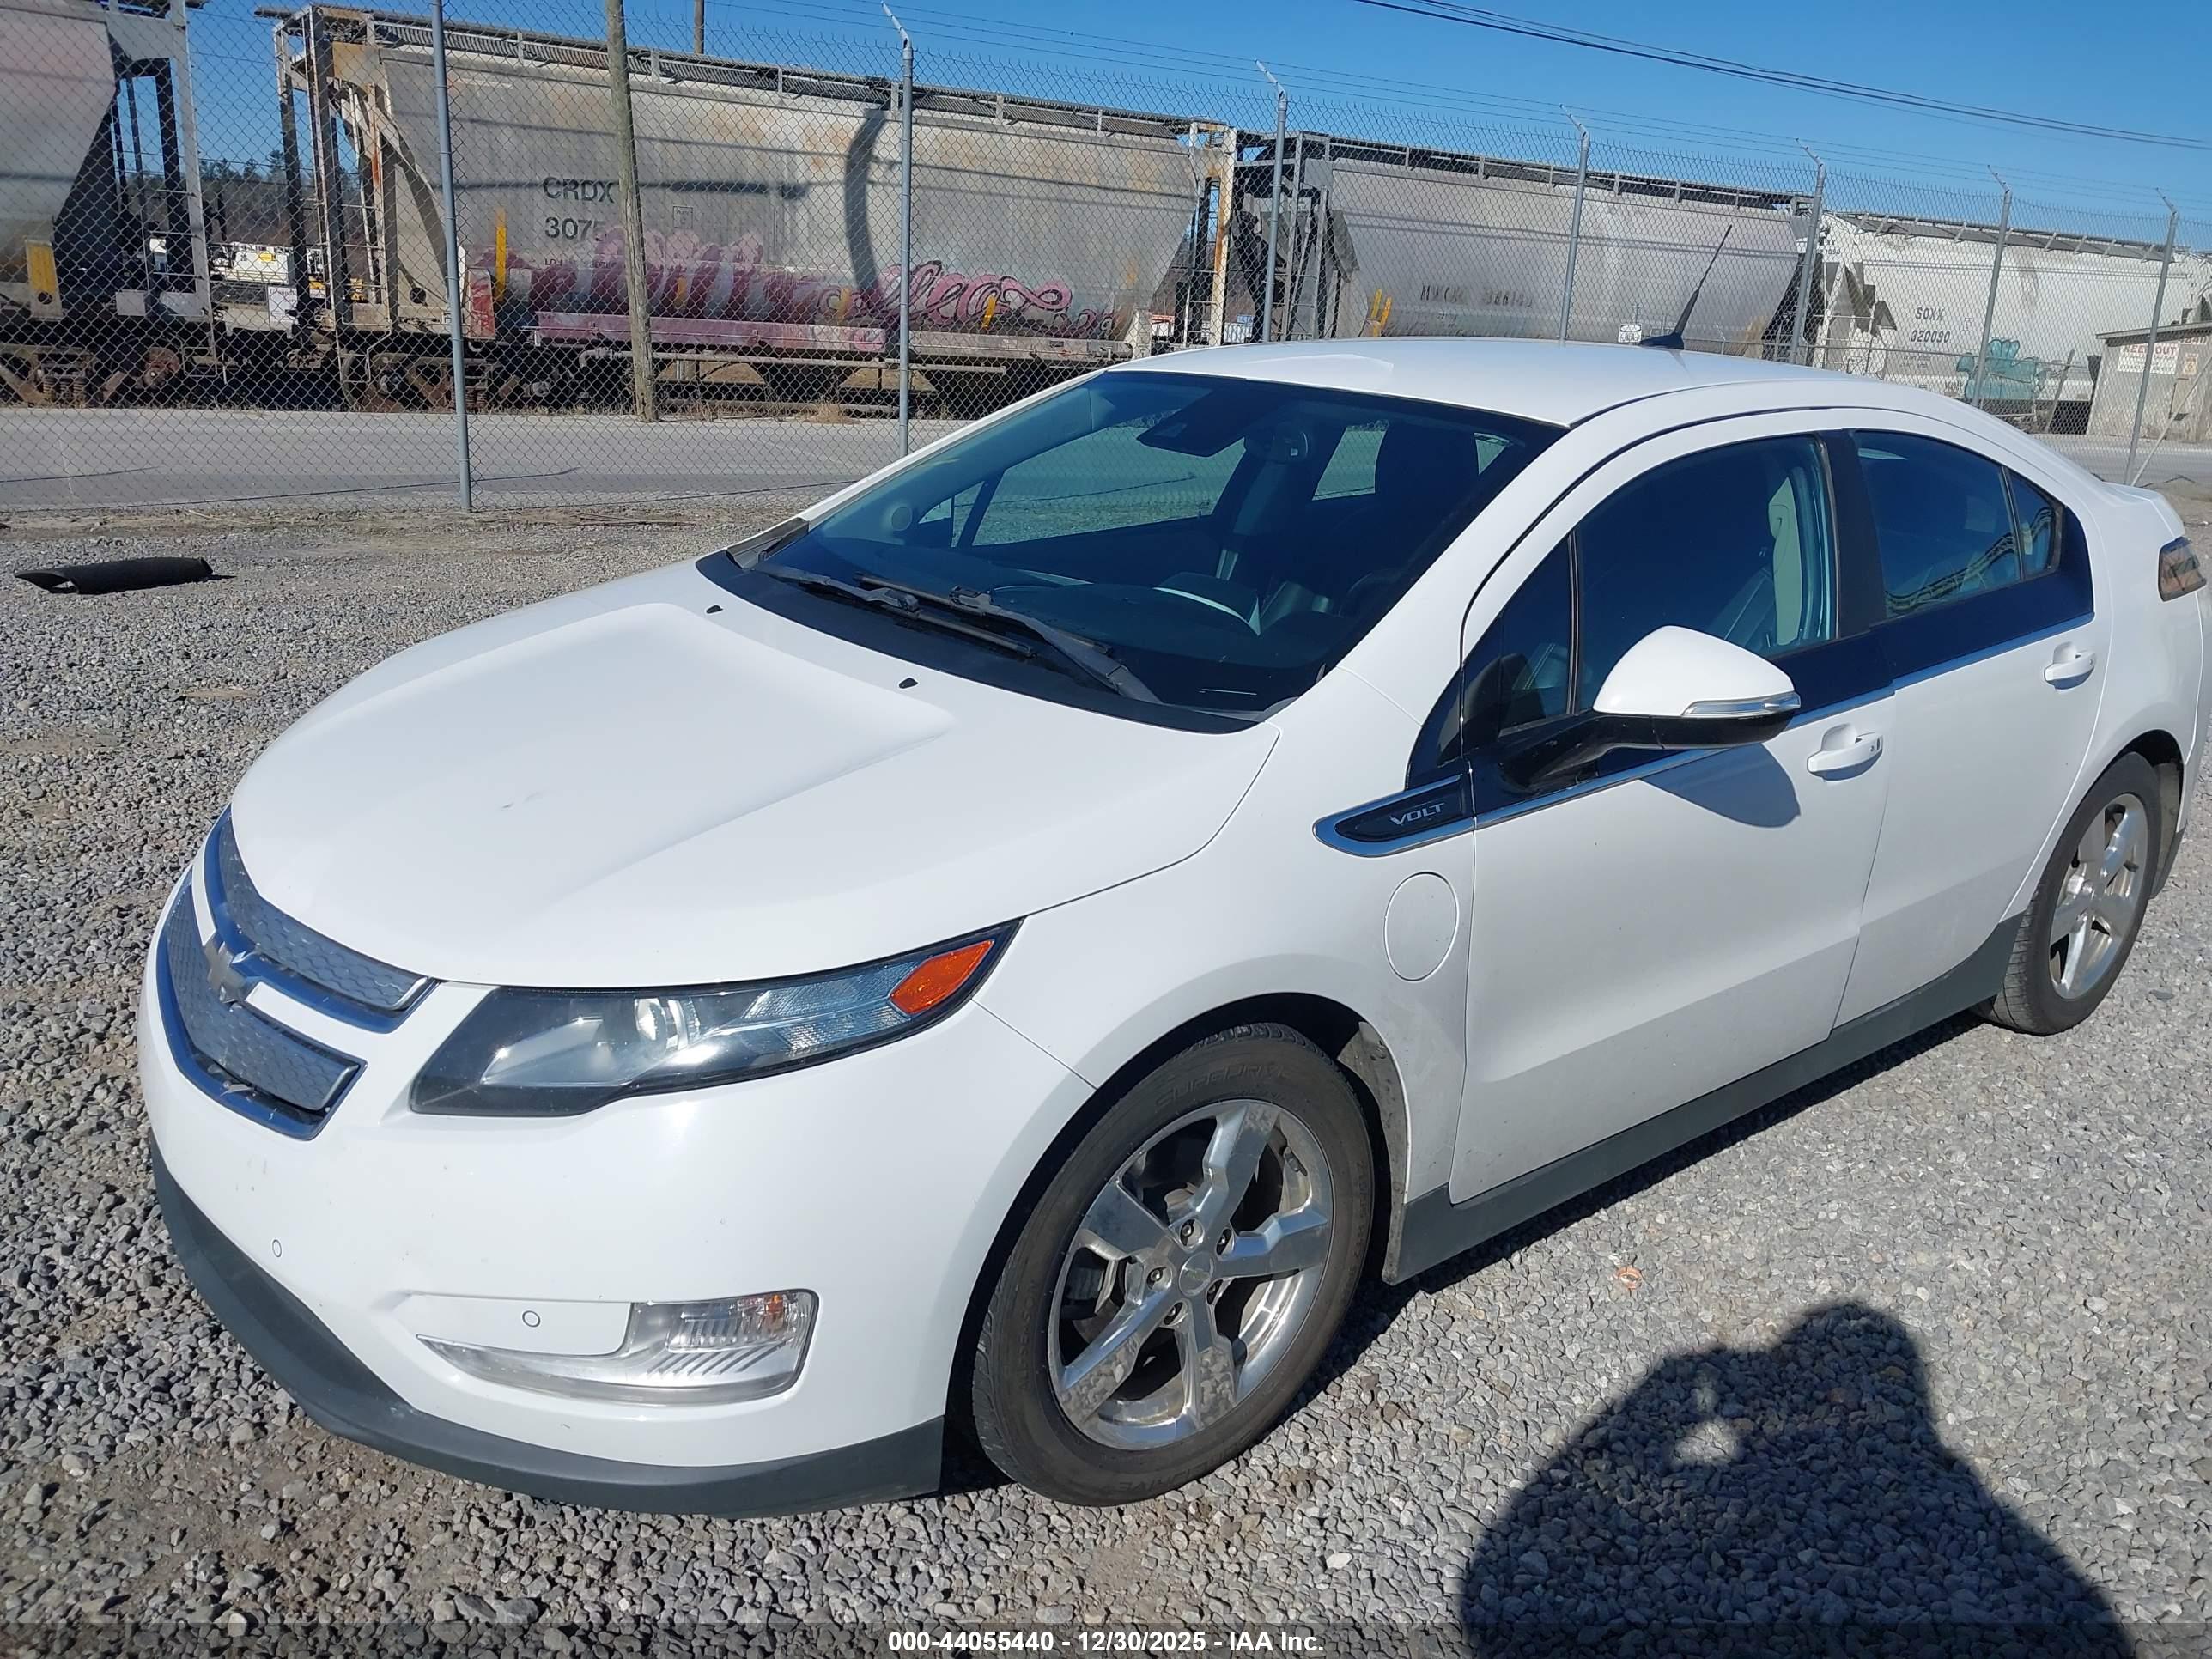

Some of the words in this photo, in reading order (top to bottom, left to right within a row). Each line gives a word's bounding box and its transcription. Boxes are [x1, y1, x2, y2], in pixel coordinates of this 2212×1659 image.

[543, 176, 614, 204] CRDX
[1911, 330, 1951, 343] 320090
[2123, 345, 2148, 354] KEE
[2155, 346, 2177, 355] OUT
[1389, 802, 1445, 825] VOLT
